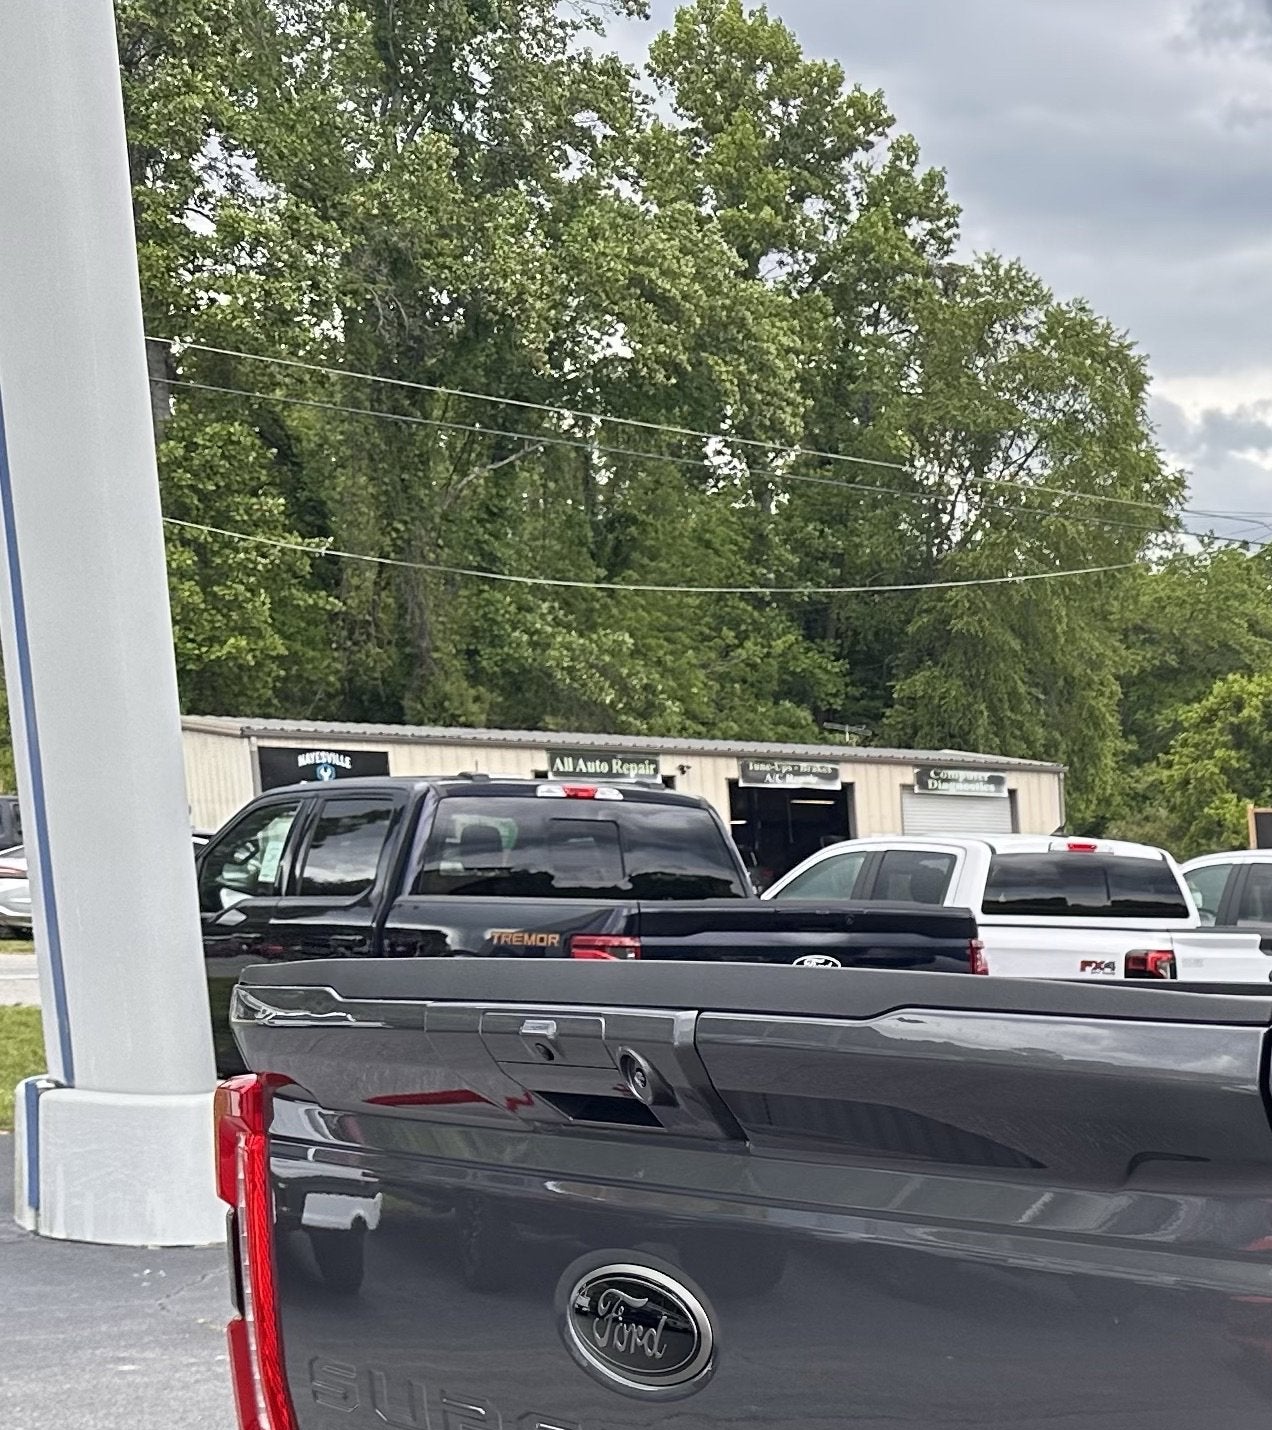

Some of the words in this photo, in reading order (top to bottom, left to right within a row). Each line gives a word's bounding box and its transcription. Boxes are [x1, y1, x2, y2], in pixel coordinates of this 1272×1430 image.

[553, 757, 574, 772] All
[576, 758, 609, 773] Auto
[612, 759, 657, 778] Repair
[493, 932, 560, 946] TREMOR
[592, 1288, 668, 1359] Ford
